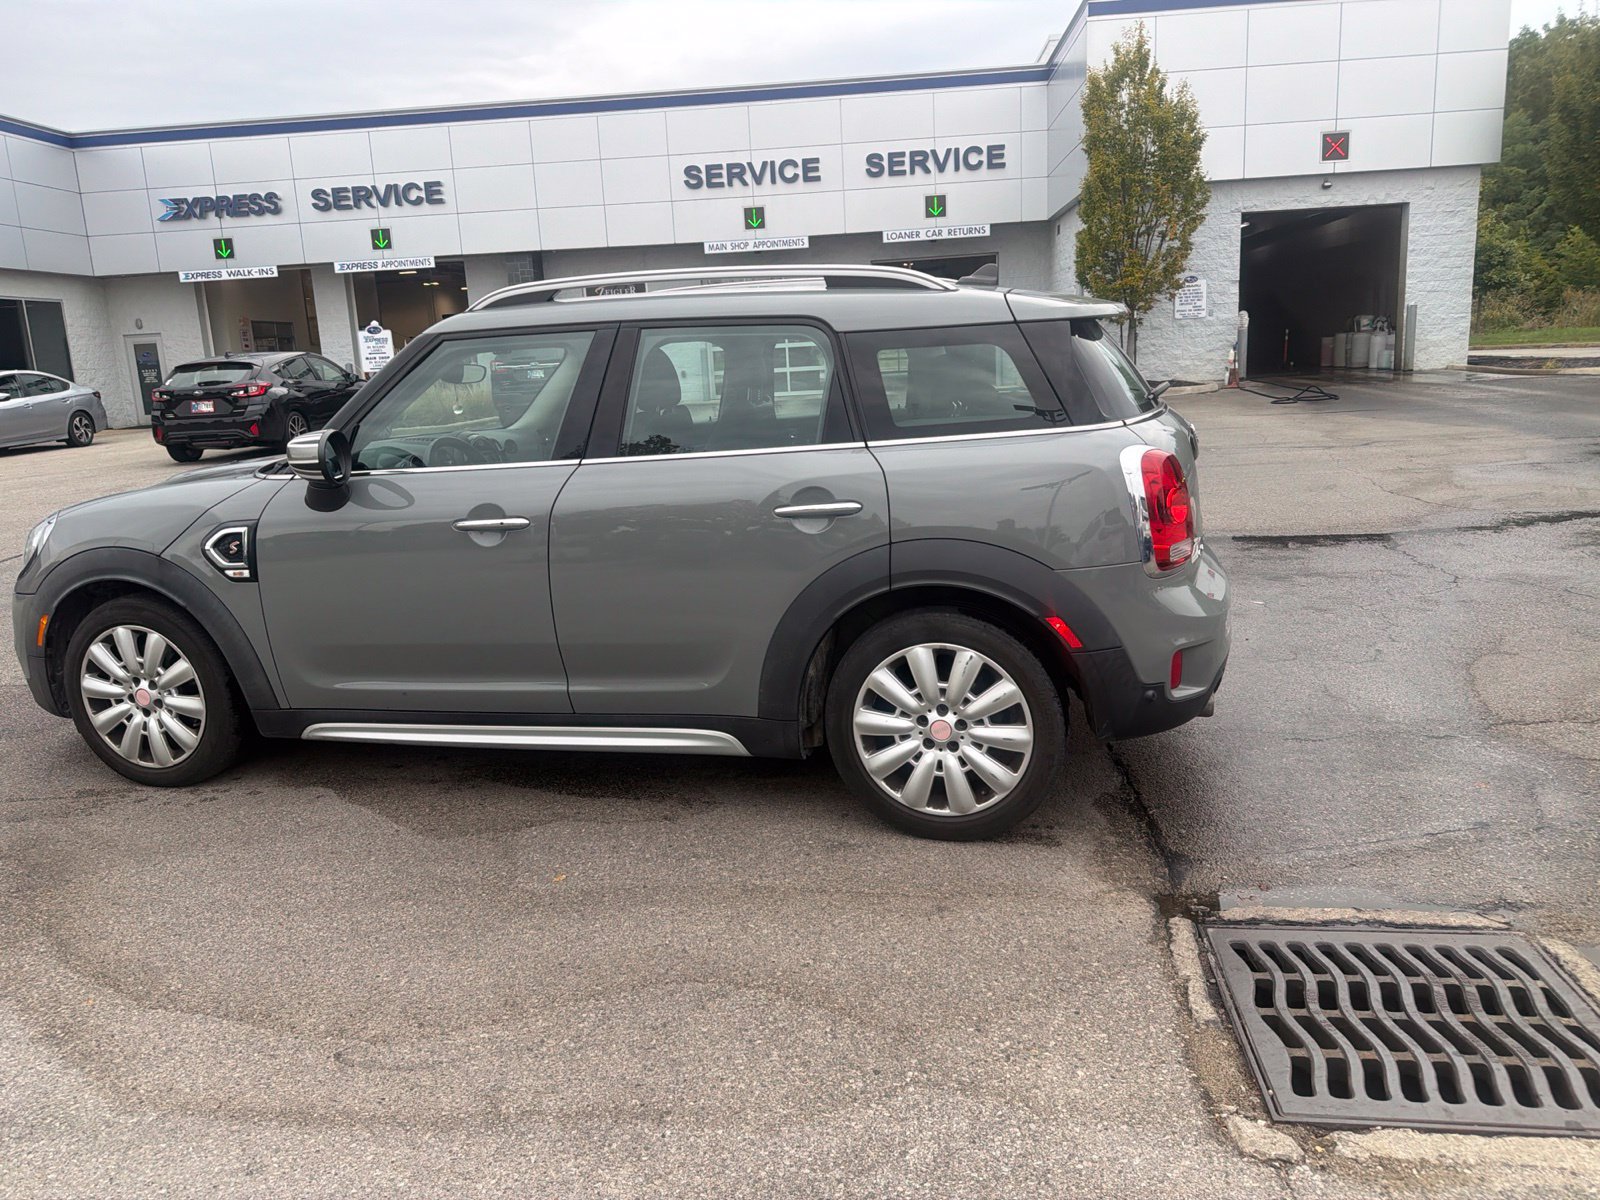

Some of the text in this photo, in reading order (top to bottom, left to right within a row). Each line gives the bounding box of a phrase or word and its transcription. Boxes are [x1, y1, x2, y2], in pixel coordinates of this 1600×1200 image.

[865, 144, 1007, 177] SERVICE
[683, 157, 822, 190] SERVICE
[310, 180, 446, 212] SERVICE
[157, 191, 282, 222] EXPRESS
[885, 225, 987, 241] LOANER CAR RETURNS
[707, 238, 806, 252] MAIN SHOP APPOINTMENTS
[337, 257, 432, 272] EXPRESS APPOINTMENTS
[182, 266, 275, 281] EXPRESS WALK-INS
[594, 285, 636, 297] ZEIGLER
